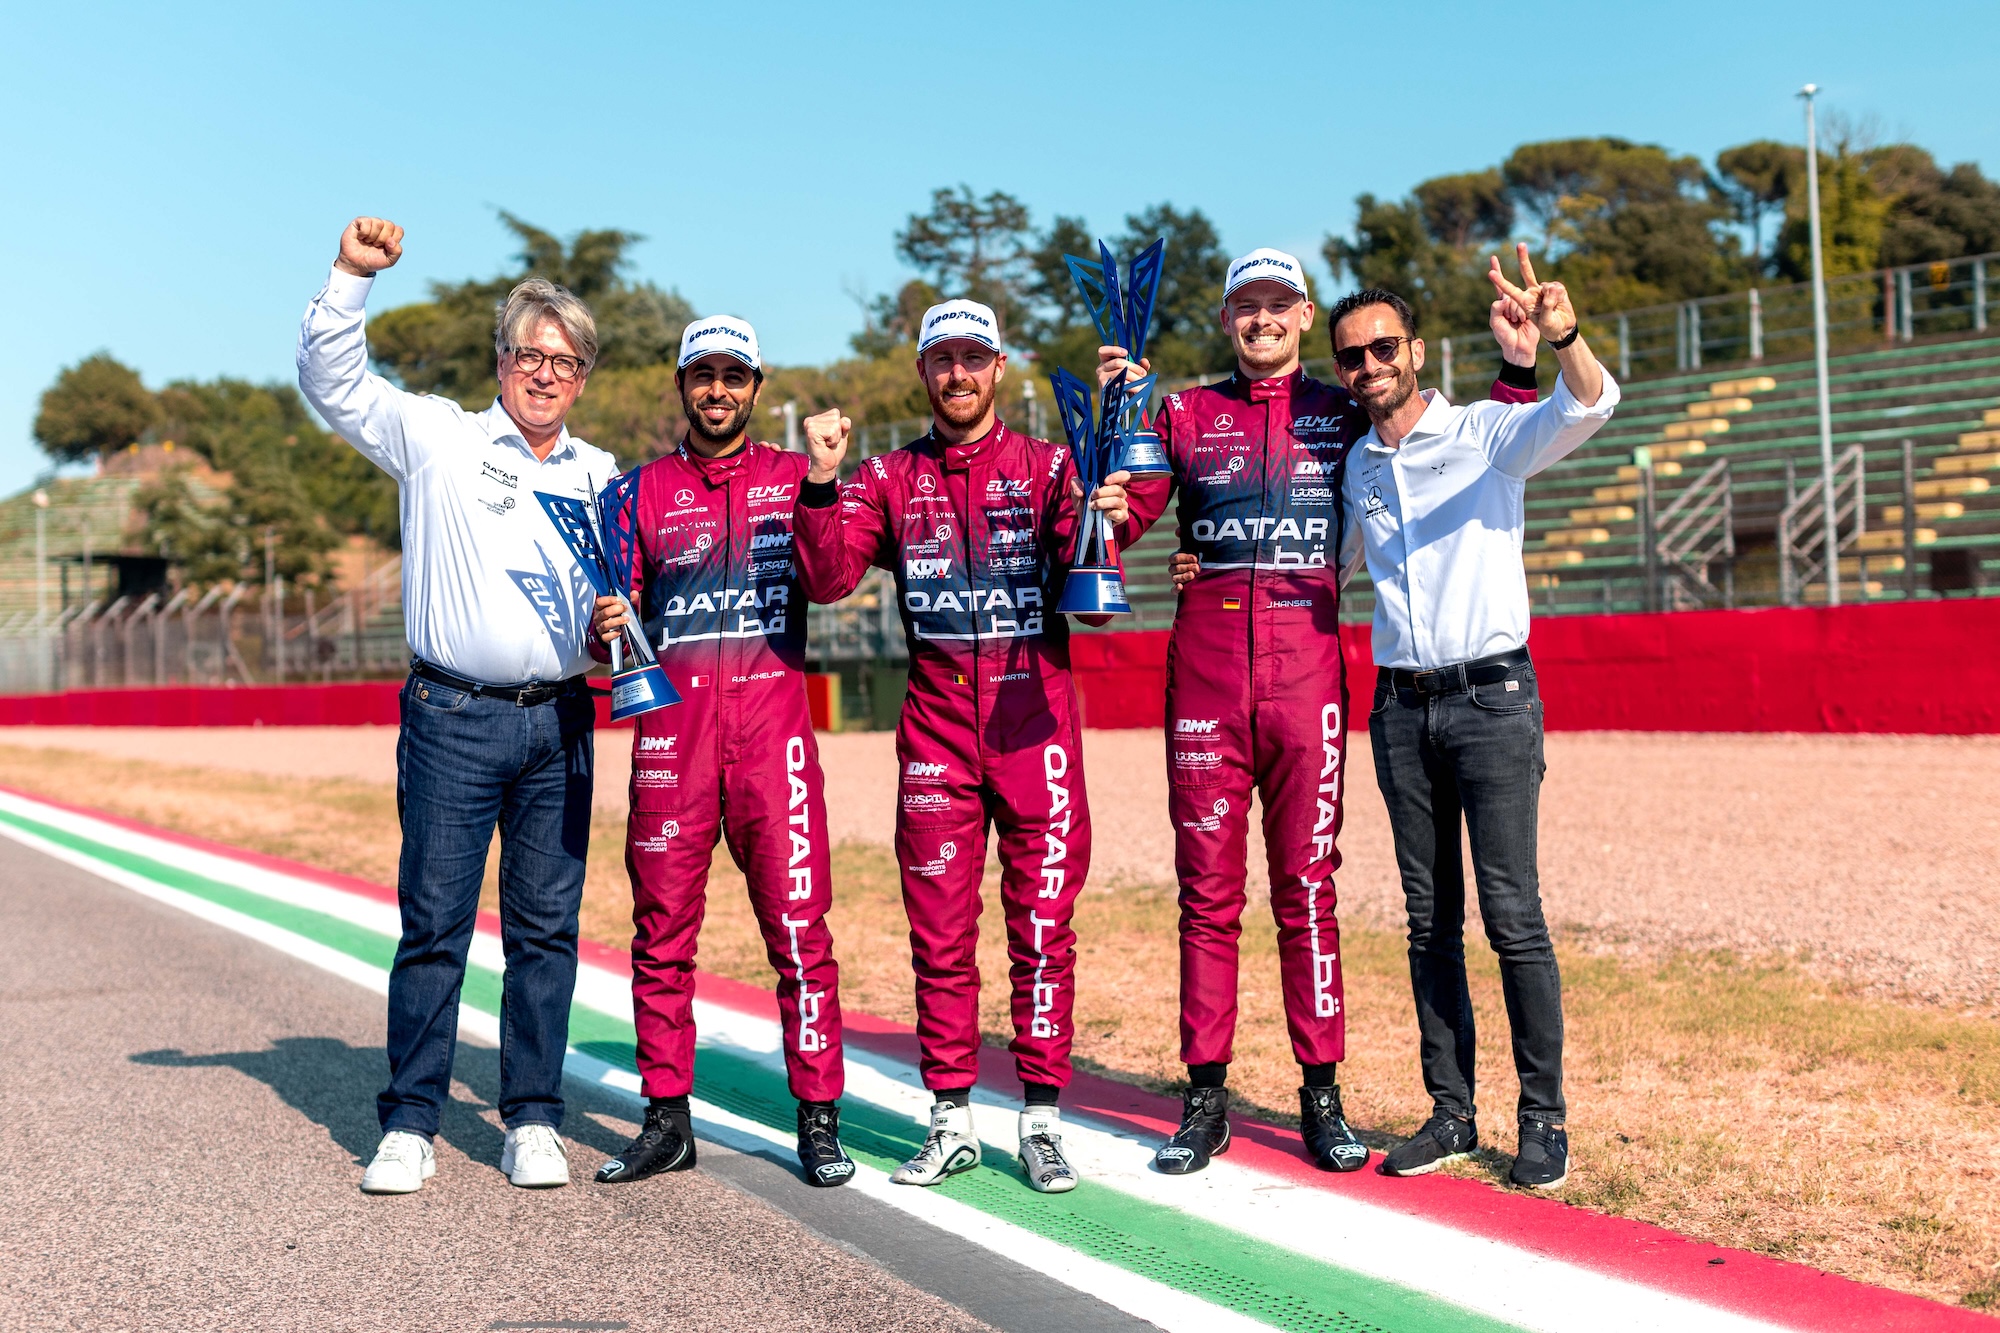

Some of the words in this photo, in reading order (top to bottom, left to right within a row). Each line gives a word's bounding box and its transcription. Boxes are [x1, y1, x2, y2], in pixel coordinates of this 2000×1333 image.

[1231, 257, 1293, 278] GOODYEAR
[929, 310, 990, 329] GOODYEAR
[689, 326, 750, 344] GOODYEAR
[1293, 415, 1344, 428] ELMS
[1293, 441, 1344, 450] GOODYEAR
[870, 456, 889, 480] HRX
[1048, 446, 1066, 480] HRX
[1294, 461, 1338, 475] QMMF
[482, 461, 518, 482] QATAR
[747, 484, 794, 499] ELMS
[986, 478, 1034, 492] ELMS
[1290, 487, 1333, 498] LUSAIL
[903, 512, 921, 520] IRON
[986, 507, 1034, 517] GOODYEAR
[658, 526, 679, 536] IRON
[695, 521, 717, 529] LYNX
[1191, 517, 1329, 541] QATAR
[665, 554, 700, 565] MOTORSPORTS
[677, 558, 700, 566] ACADEMY
[906, 558, 952, 576] KDW
[664, 585, 789, 617] QATAR
[905, 586, 1044, 613] QATAR
[912, 610, 1044, 641] قطر
[989, 673, 1030, 683] M.MARTIN
[1175, 718, 1219, 733] QMMF
[638, 736, 677, 750] QMMF
[1175, 751, 1223, 762] LUSAIL
[636, 769, 678, 779] LUSAIL
[905, 761, 949, 777] QMMF
[1309, 702, 1341, 864] QATAR
[903, 794, 950, 805] LUSAIL
[786, 736, 812, 901] QATAR
[1038, 744, 1072, 900] QATAR
[1183, 820, 1220, 828] MOTORSPORTS
[921, 869, 946, 877] ACADEMY
